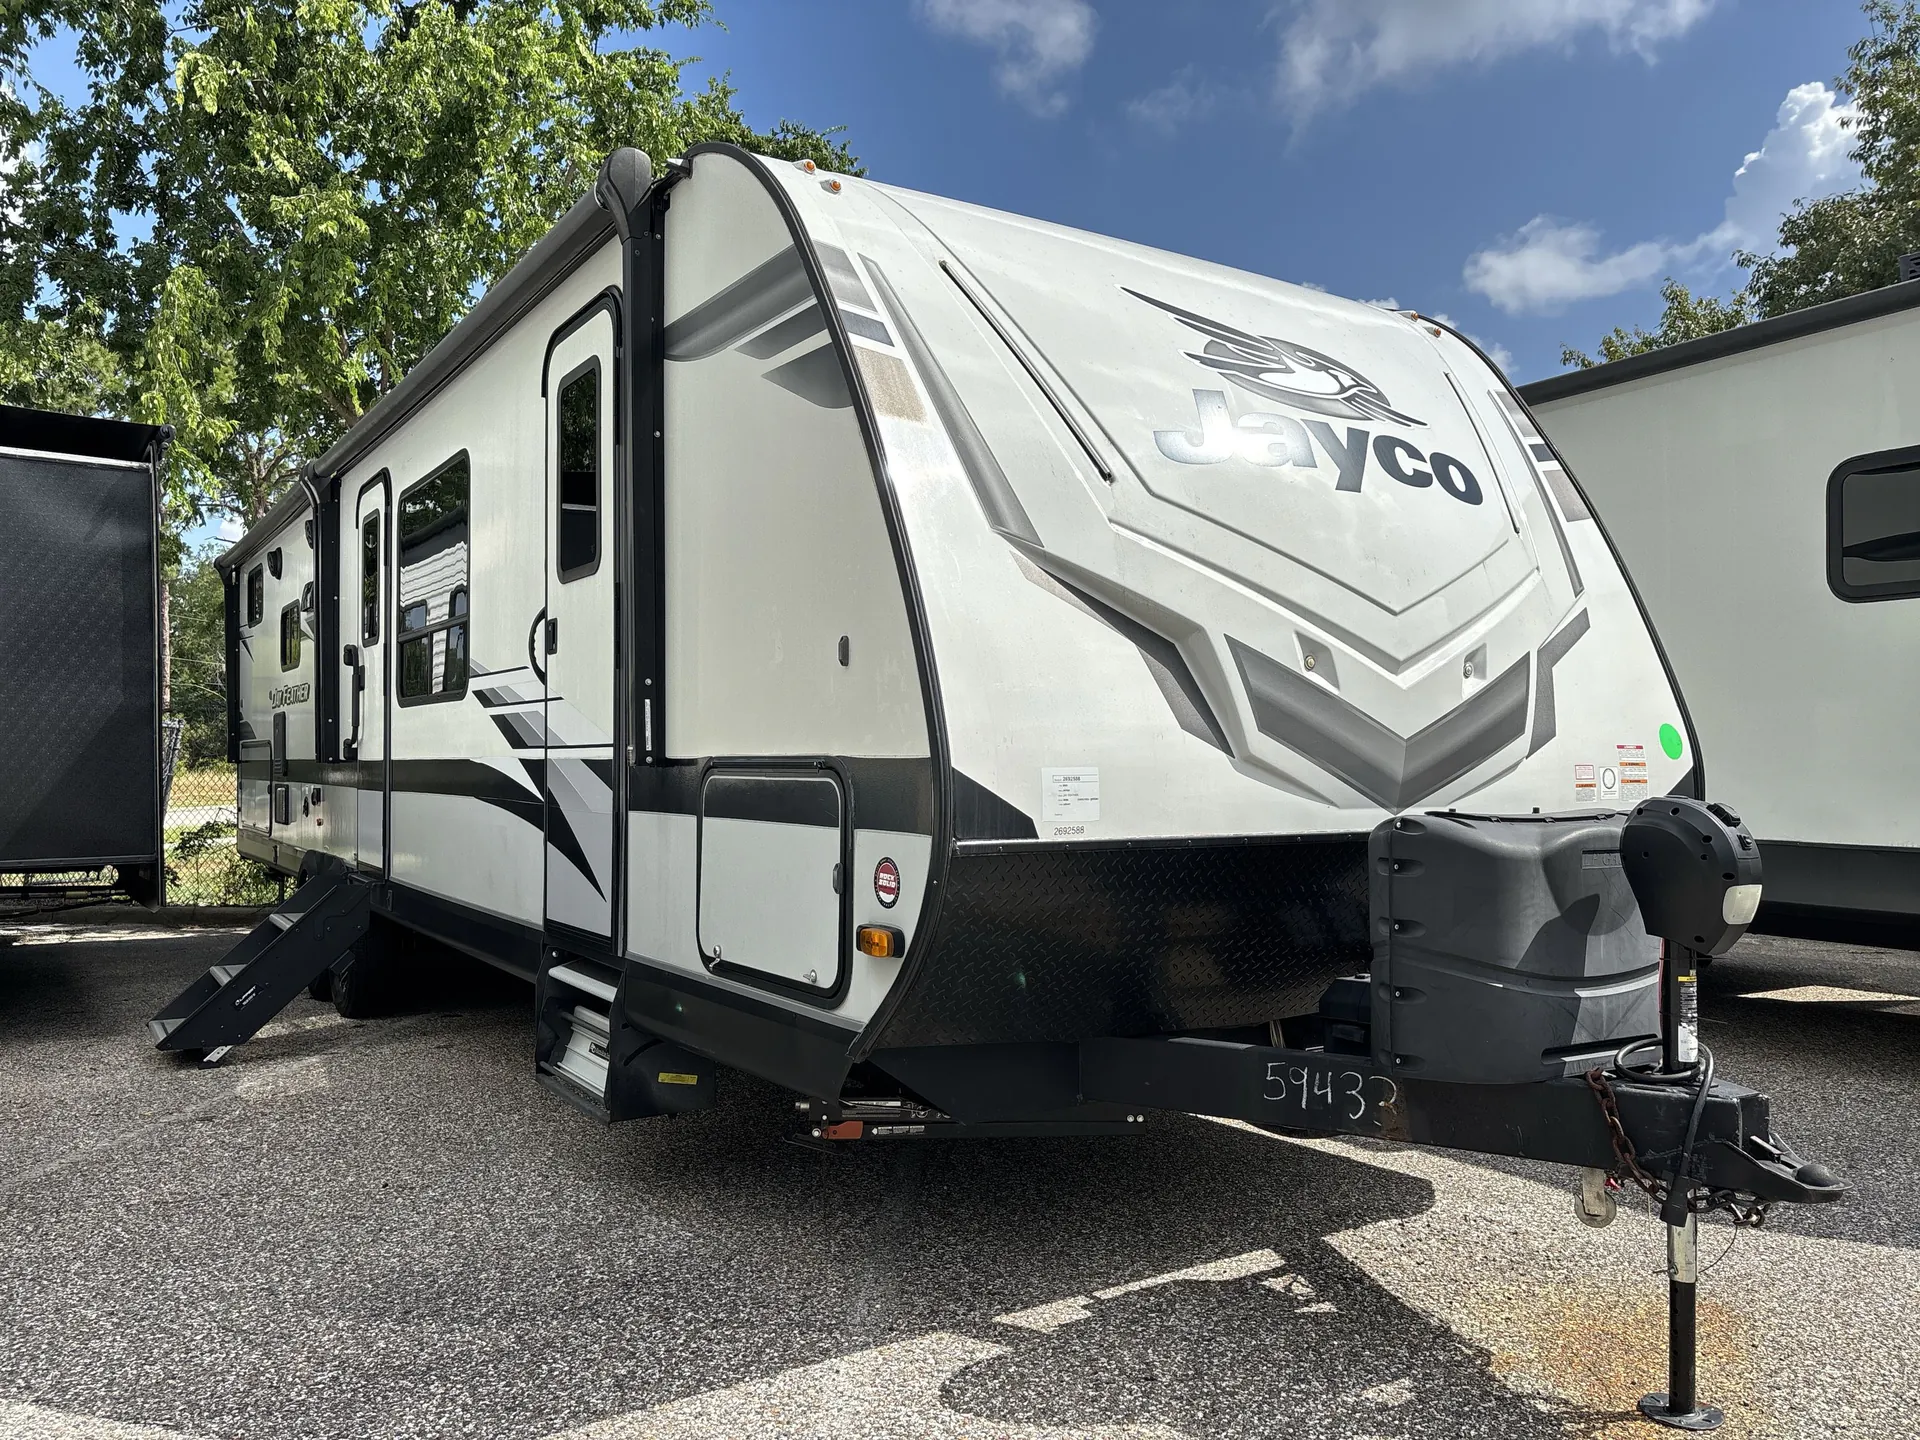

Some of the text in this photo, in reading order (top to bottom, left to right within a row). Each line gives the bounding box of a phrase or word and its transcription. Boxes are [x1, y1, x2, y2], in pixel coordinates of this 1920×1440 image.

[1153, 388, 1483, 506] Jayco
[1053, 825, 1085, 836] 2692588
[879, 872, 896, 881] ROCK
[878, 879, 896, 888] SOLID
